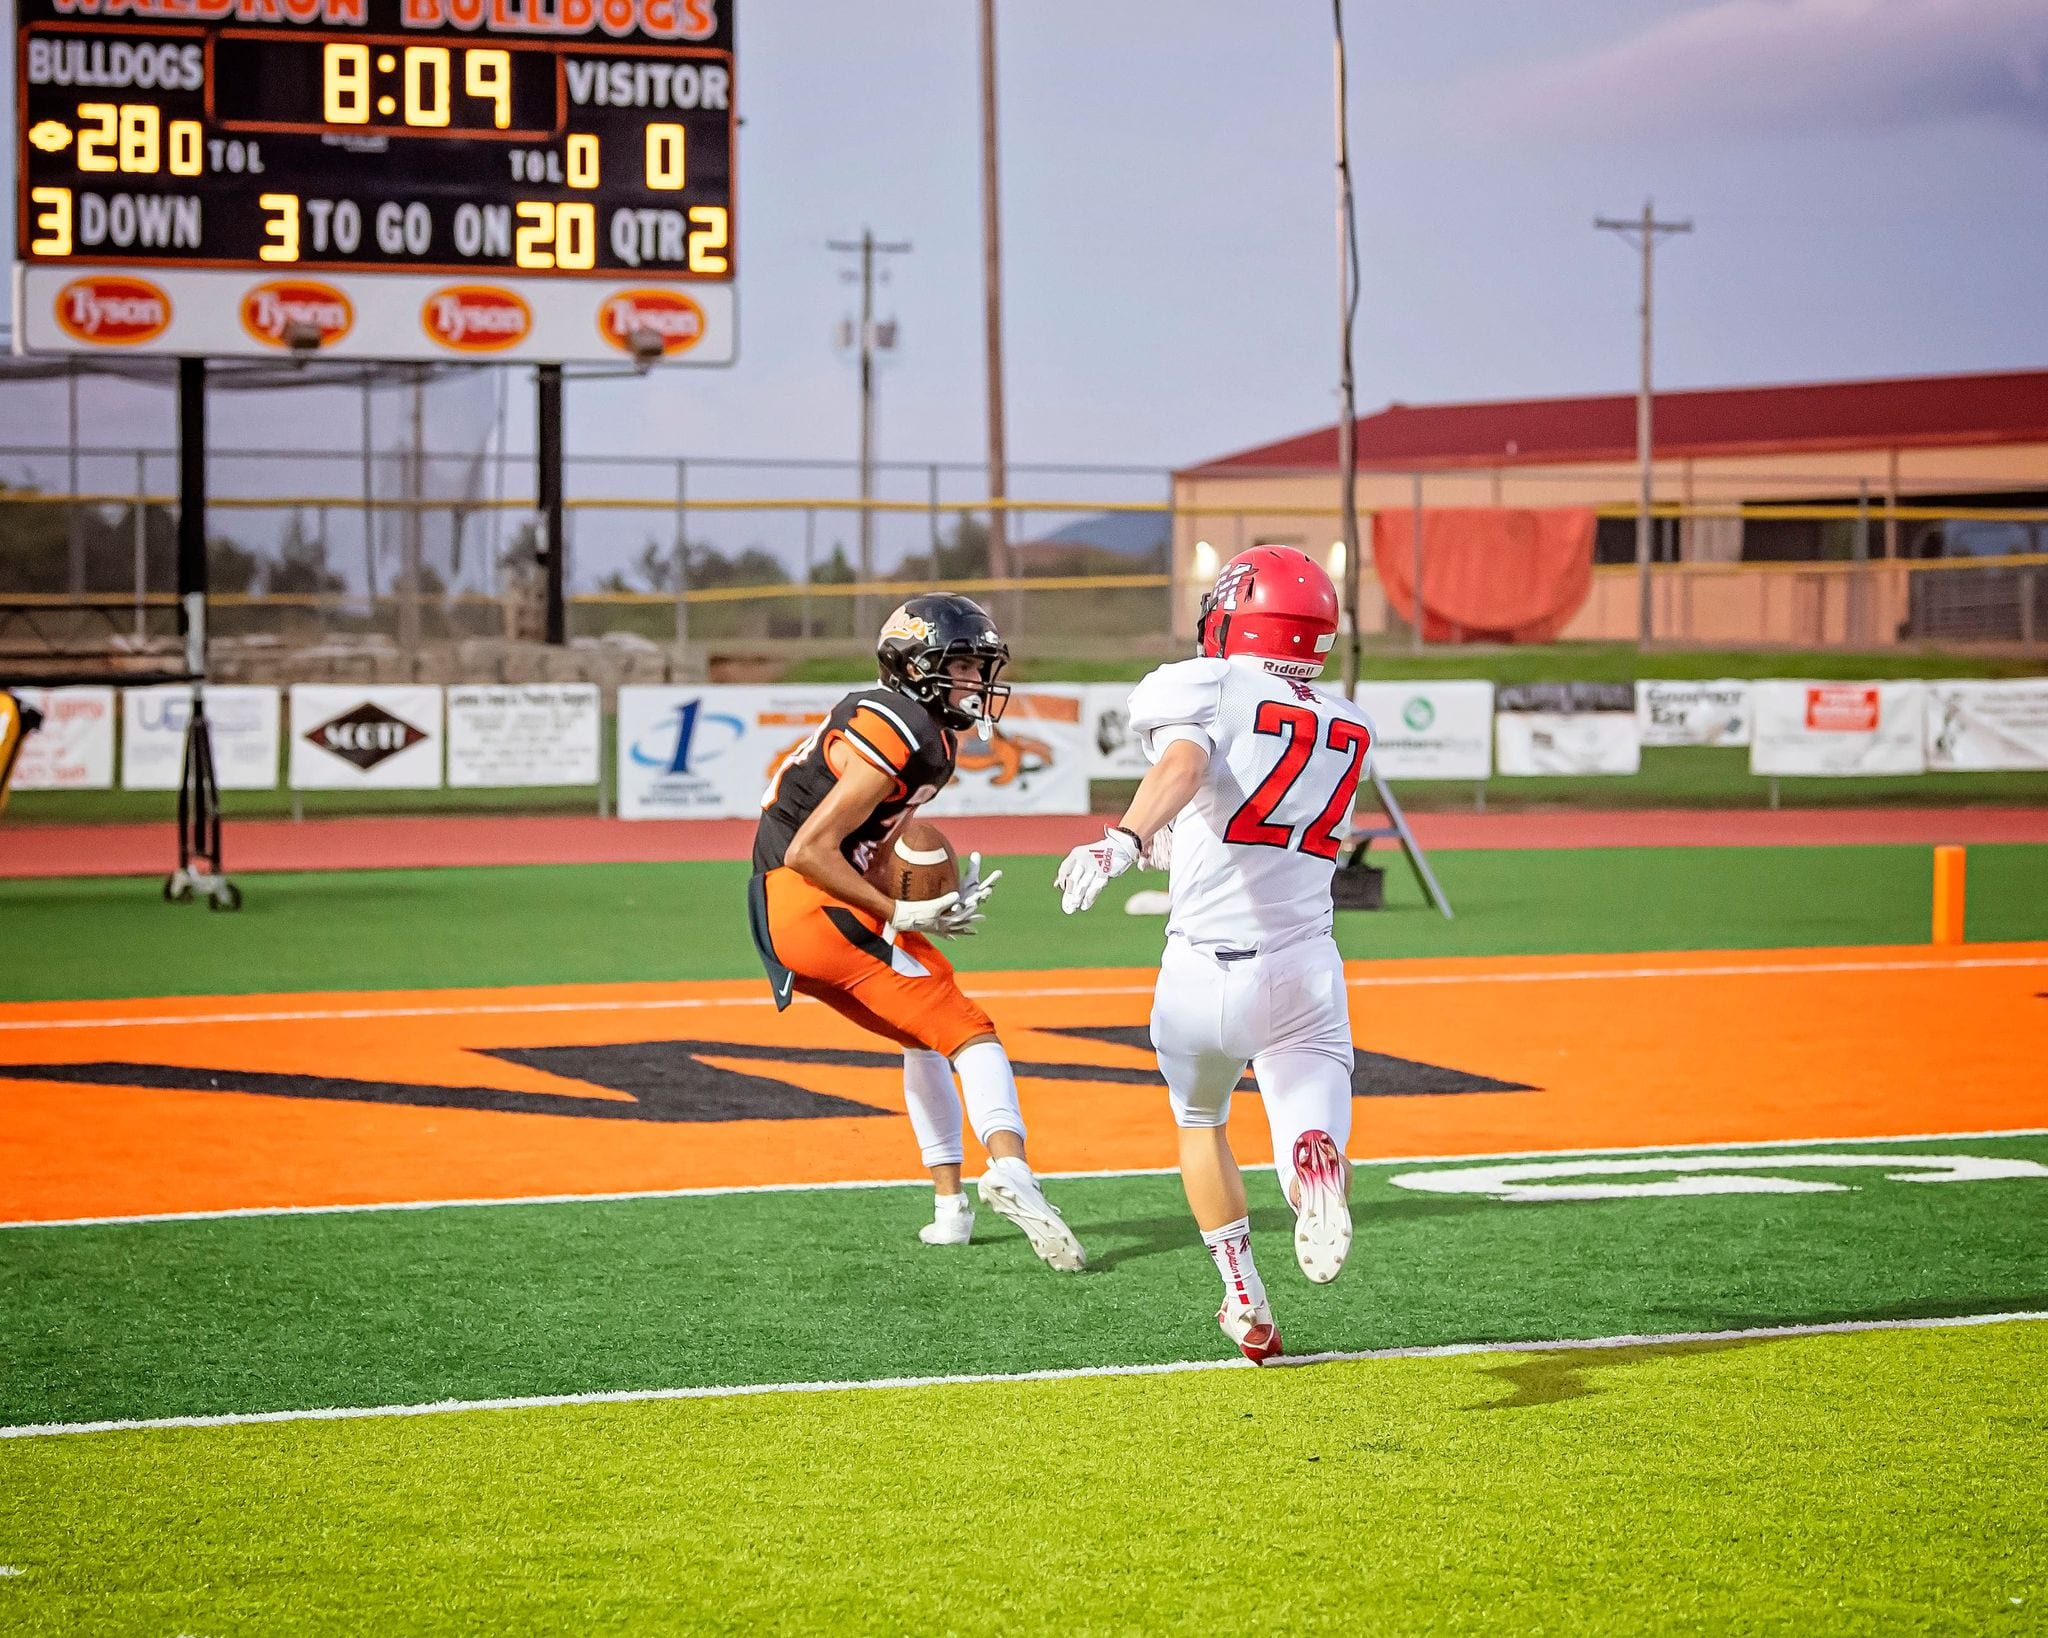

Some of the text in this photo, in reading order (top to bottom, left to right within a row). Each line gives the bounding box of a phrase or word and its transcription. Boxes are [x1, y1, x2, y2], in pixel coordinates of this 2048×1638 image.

[28, 38, 204, 90] BULLDOGS
[324, 43, 511, 128] 8:09
[566, 60, 729, 109] VISITOR
[77, 103, 202, 176] 28 0
[208, 139, 265, 173] TOL
[508, 150, 562, 182] TOL
[567, 134, 600, 189] 0
[646, 123, 685, 190] 0
[32, 186, 72, 256] 3
[79, 192, 201, 248] DOWN
[259, 193, 299, 262] 3
[306, 199, 512, 257] TO GO ON
[516, 201, 595, 270] 20
[610, 207, 687, 266] QTR
[689, 206, 728, 273] 2
[69, 286, 162, 335] Tyson
[431, 295, 524, 341] Tyson
[1263, 661, 1315, 677] Riddell
[323, 721, 407, 751] SCOTT
[1222, 700, 1371, 864] 22
